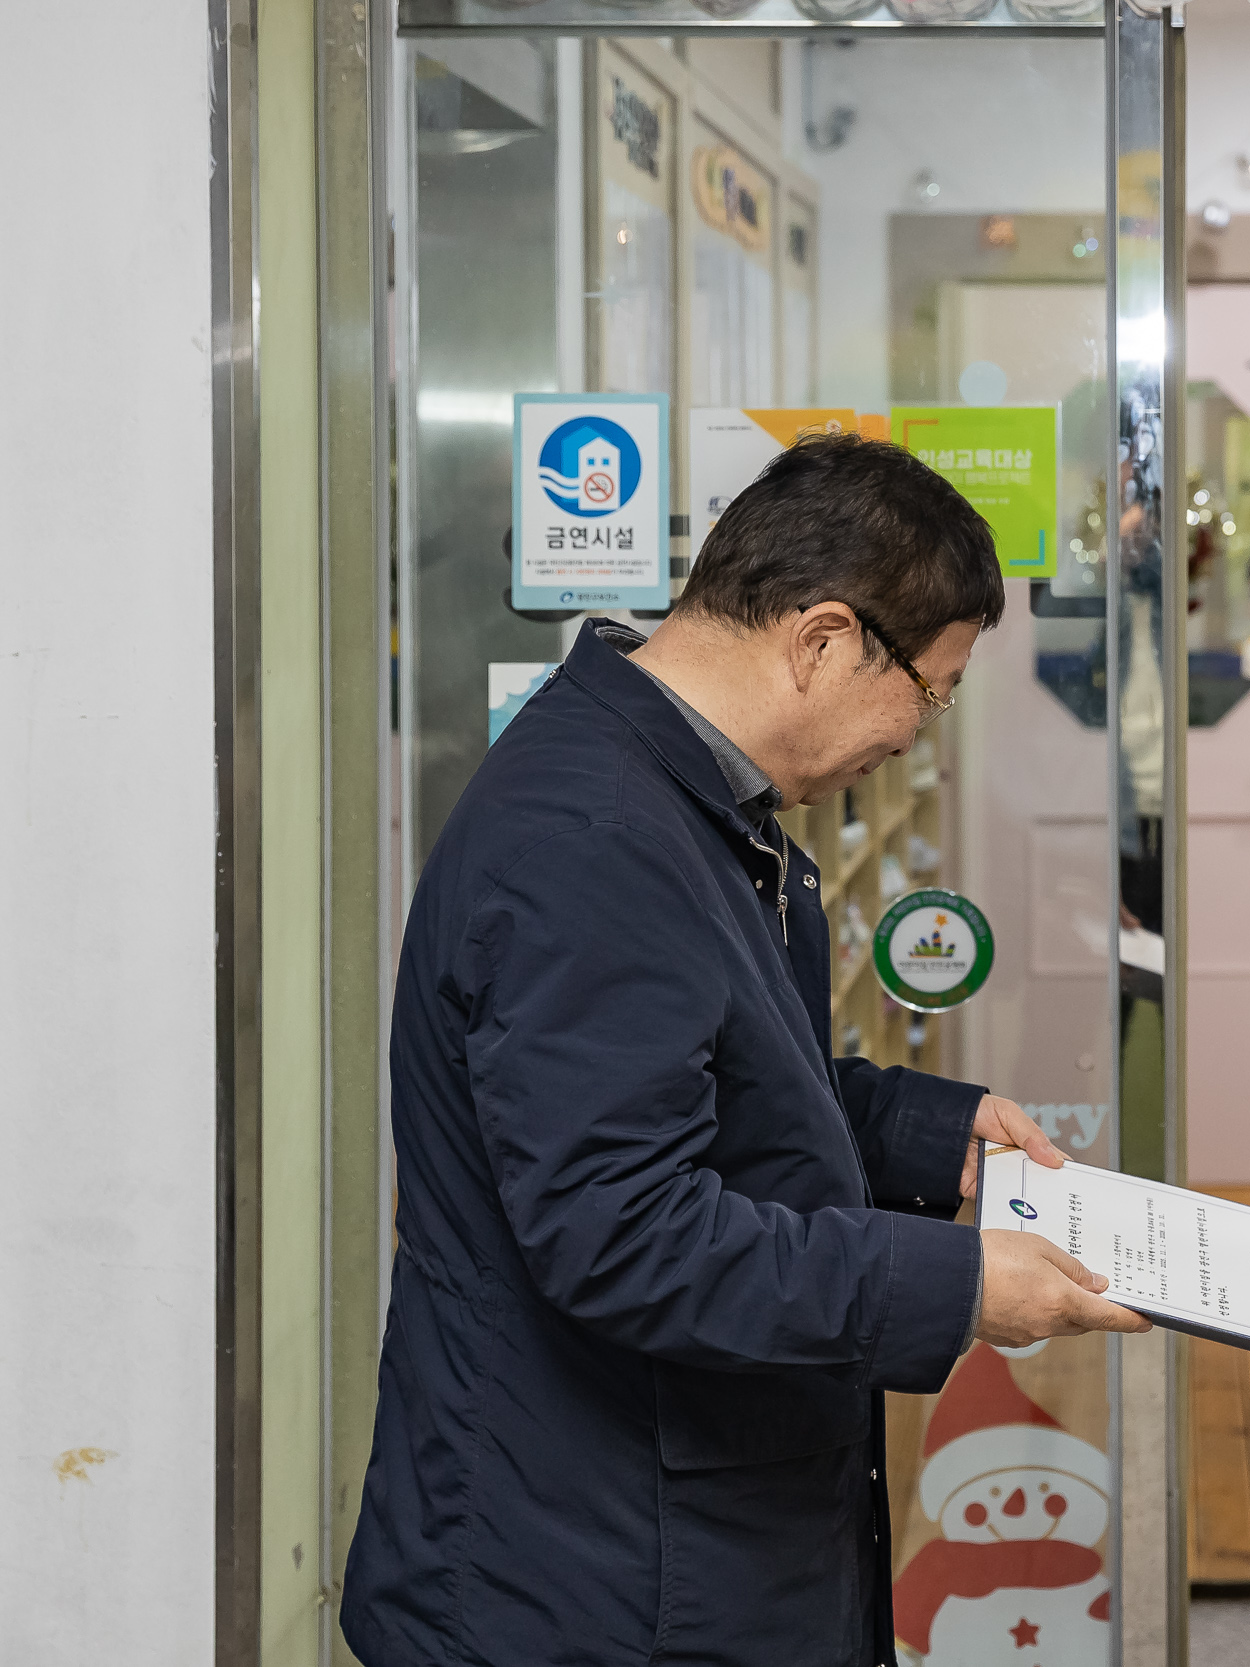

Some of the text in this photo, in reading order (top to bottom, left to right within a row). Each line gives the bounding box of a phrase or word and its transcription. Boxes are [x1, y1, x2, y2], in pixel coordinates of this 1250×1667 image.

[545, 526, 635, 550] 금연시설
[1068, 1193, 1082, 1255] 열린어린이집 선정서
[1197, 1208, 1209, 1247] 열린어린이집으로
[1199, 1250, 1210, 1266] 광진구
[1199, 1269, 1211, 1297] 어린이집을
[1218, 1286, 1229, 1316] 선정합니다.
